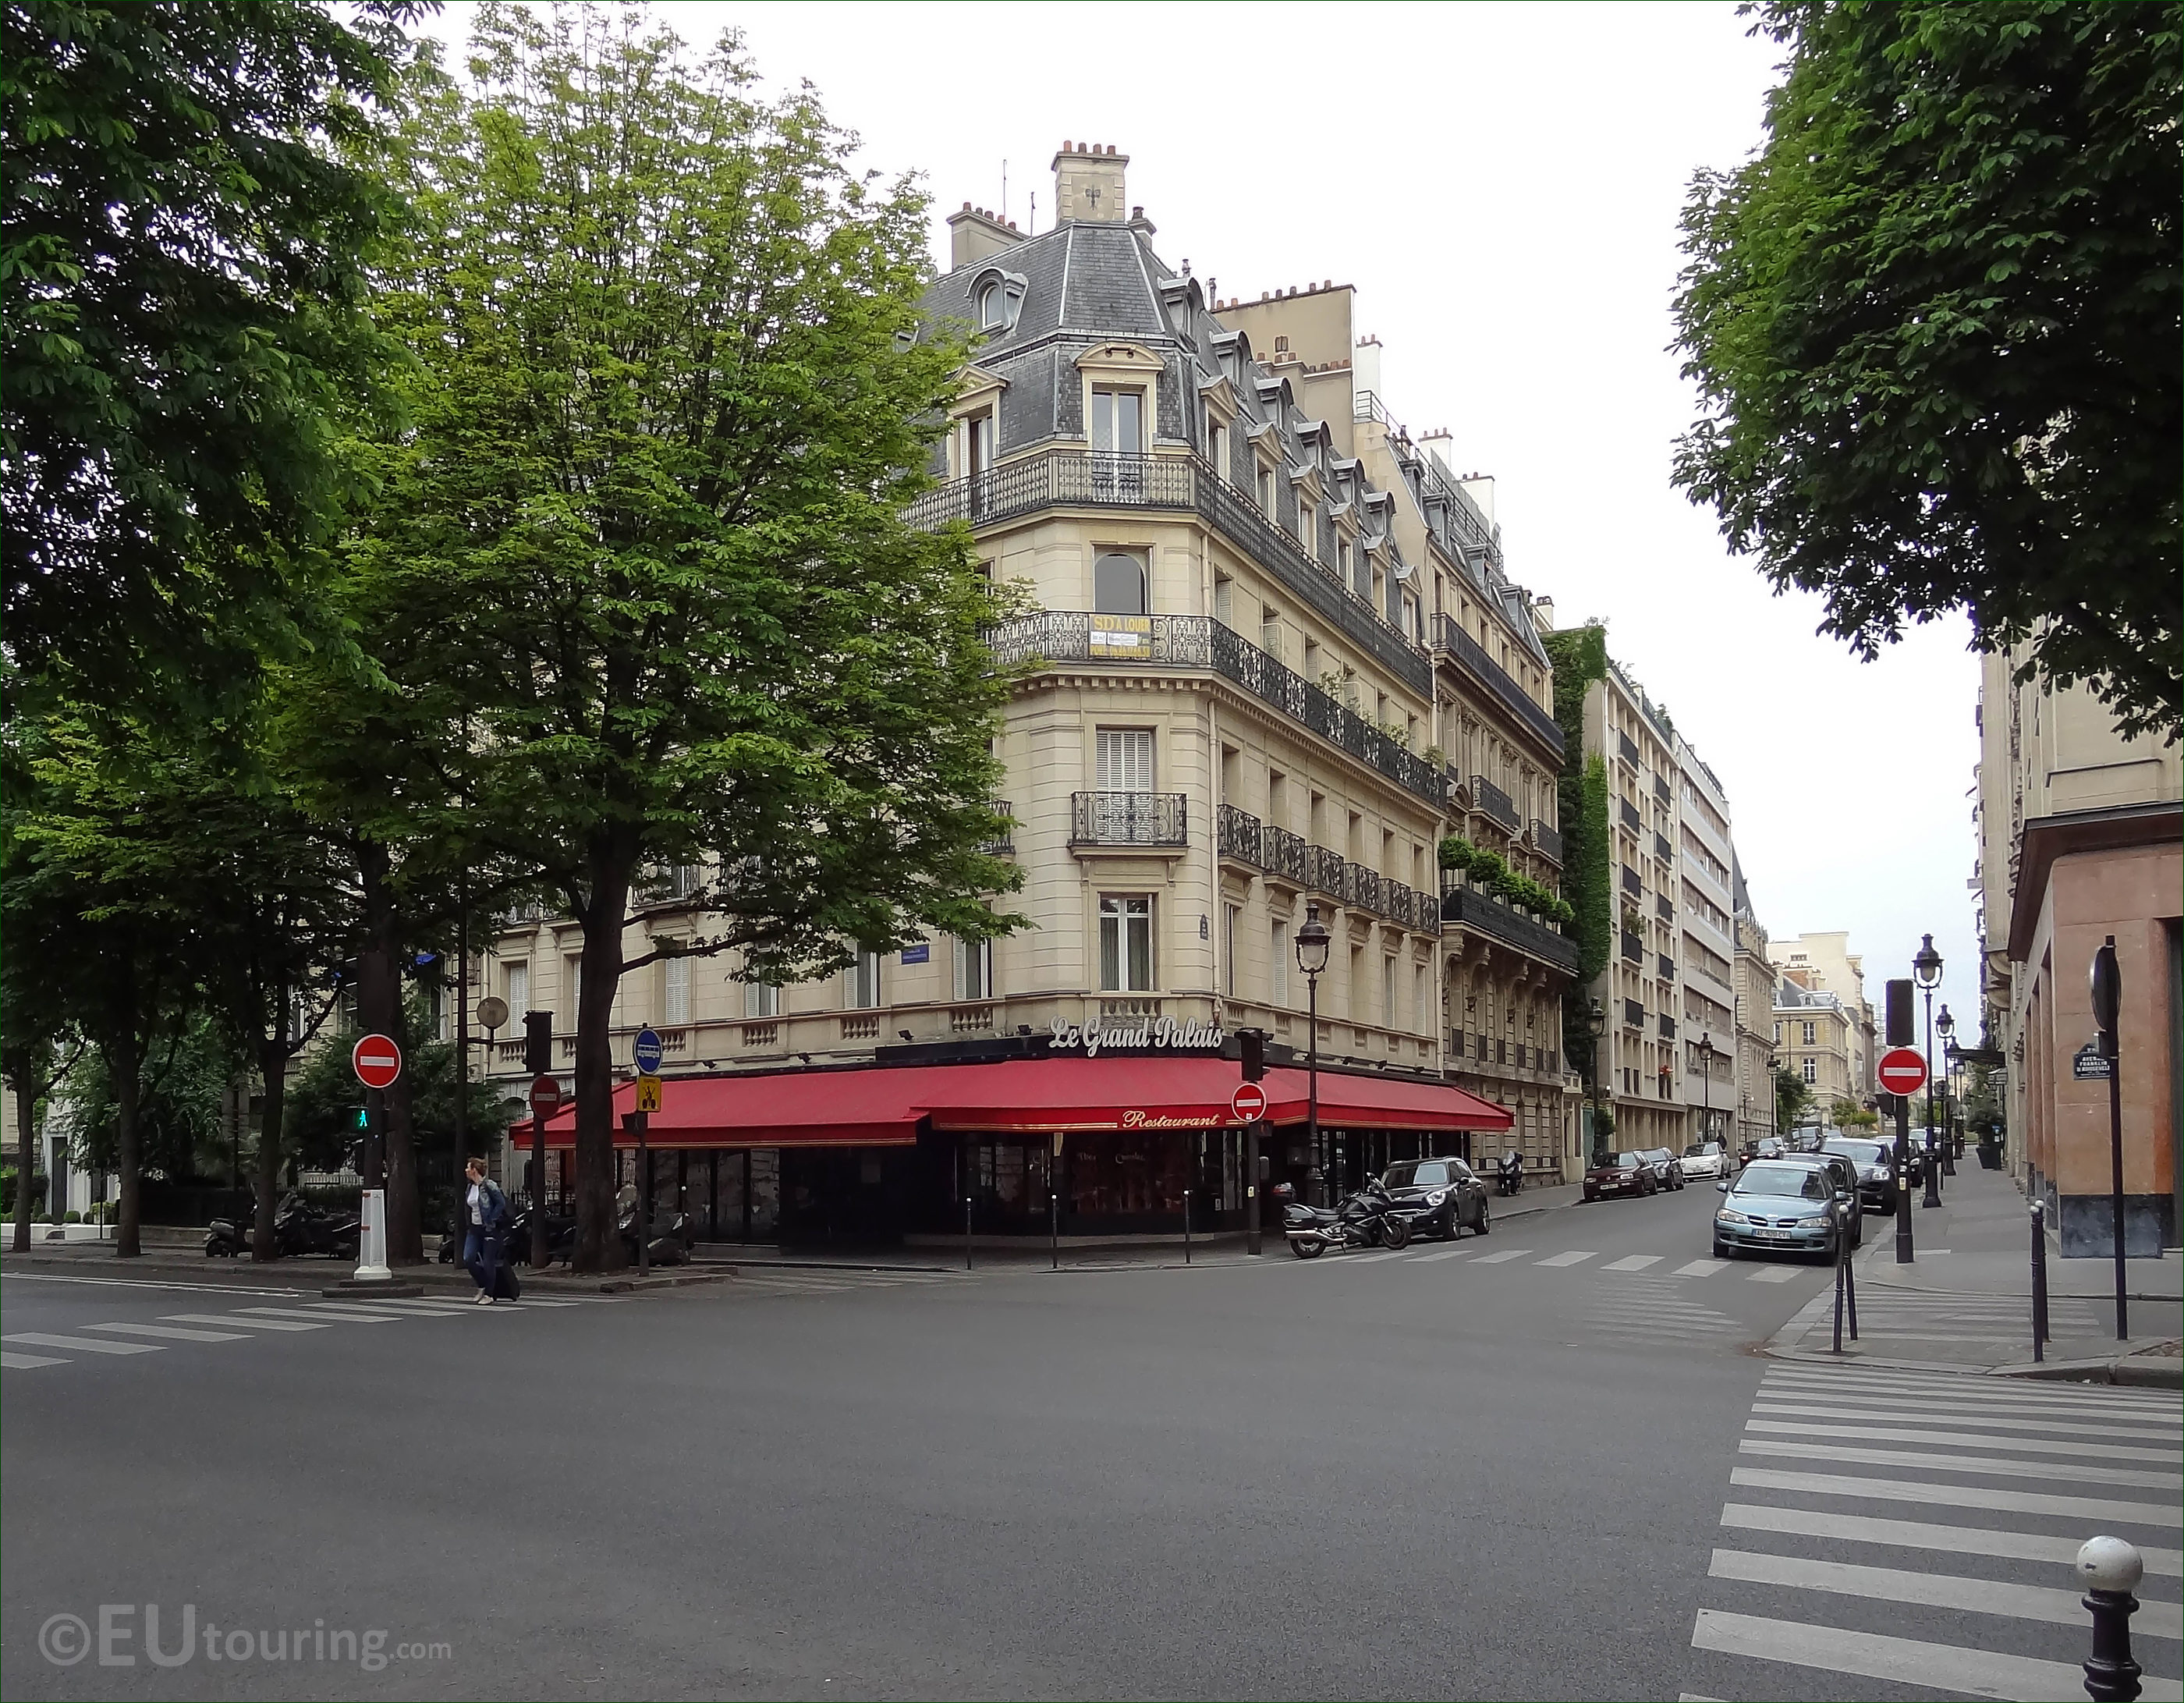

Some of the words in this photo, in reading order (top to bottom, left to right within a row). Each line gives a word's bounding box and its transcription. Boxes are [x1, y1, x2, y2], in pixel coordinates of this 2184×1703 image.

[1048, 1016, 1080, 1048] Le
[1083, 1017, 1150, 1058] Grand
[1154, 1016, 1223, 1048] Palais
[1122, 1110, 1220, 1128] Restaurant
